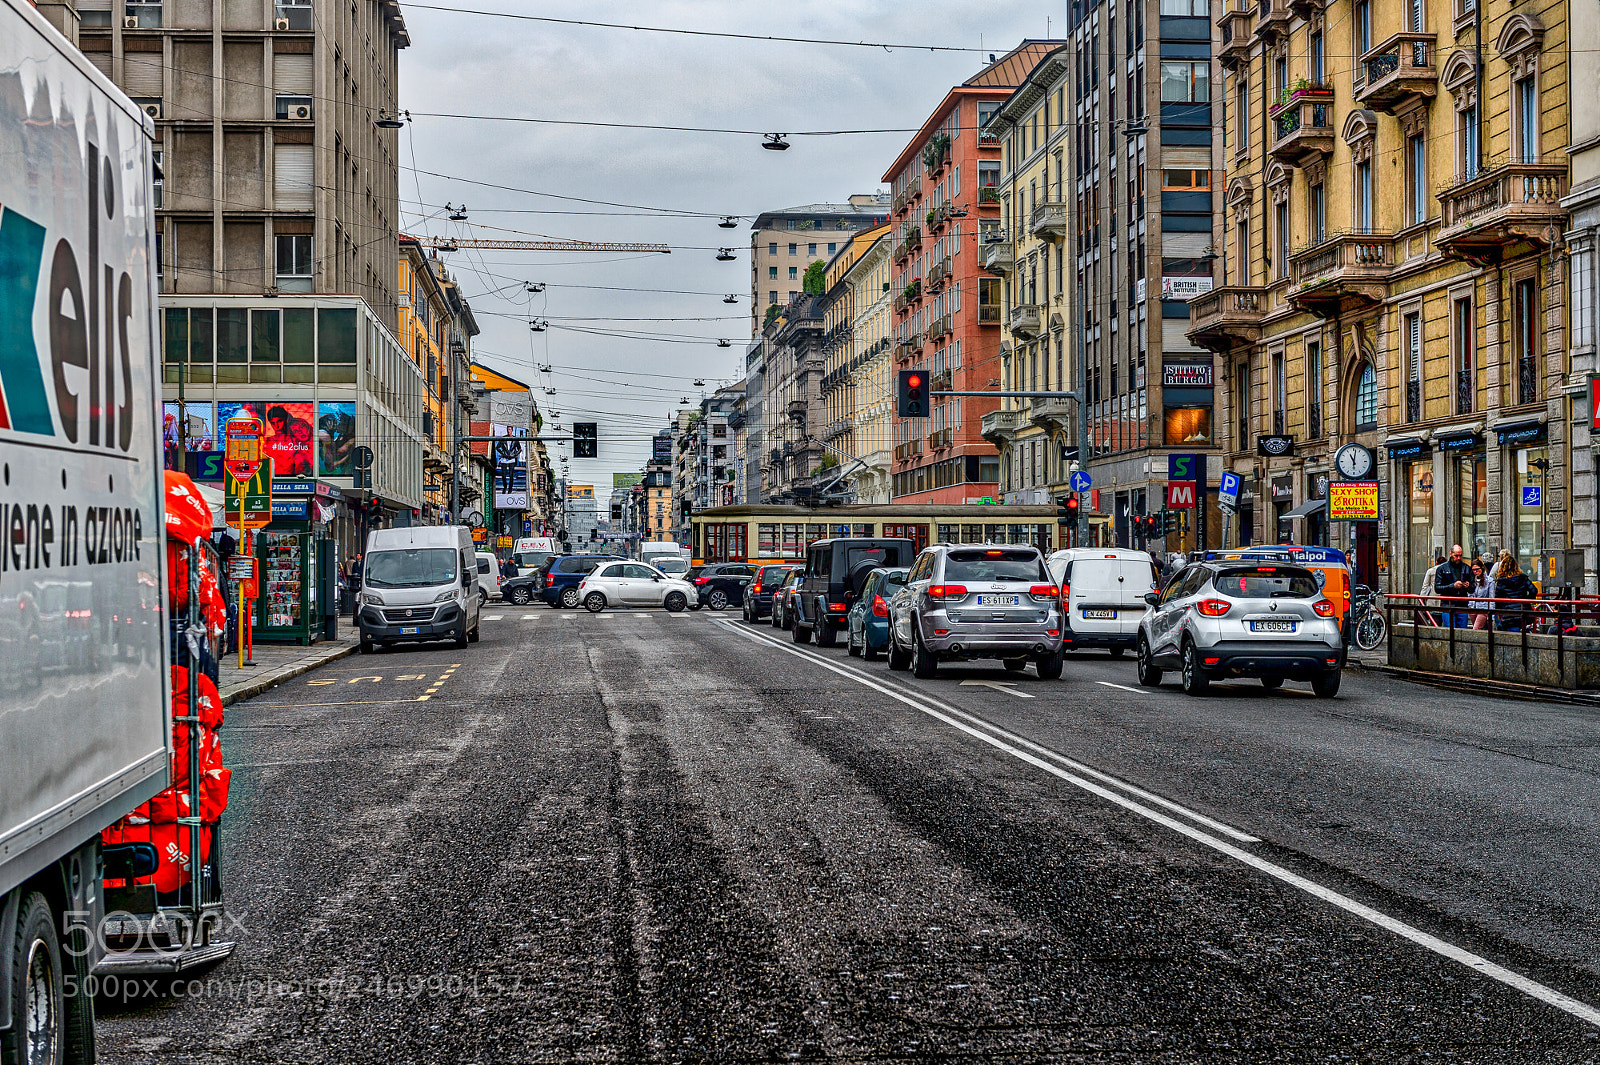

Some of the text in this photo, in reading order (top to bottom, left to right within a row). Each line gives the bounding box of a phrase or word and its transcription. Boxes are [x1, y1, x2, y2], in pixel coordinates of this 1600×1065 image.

[49, 140, 133, 452] elis
[1165, 366, 1206, 374] ISTITUTO
[1168, 375, 1204, 384] BURGO
[495, 402, 524, 415] OVS
[272, 441, 309, 451] #the2ofus
[1174, 457, 1191, 476] S
[1223, 475, 1236, 491] P
[1171, 486, 1193, 504] M
[1330, 488, 1378, 496] SEXY SHOP
[506, 496, 526, 506] OVS
[1333, 496, 1374, 507] EROTIKA
[0, 463, 142, 572] iene in azione
